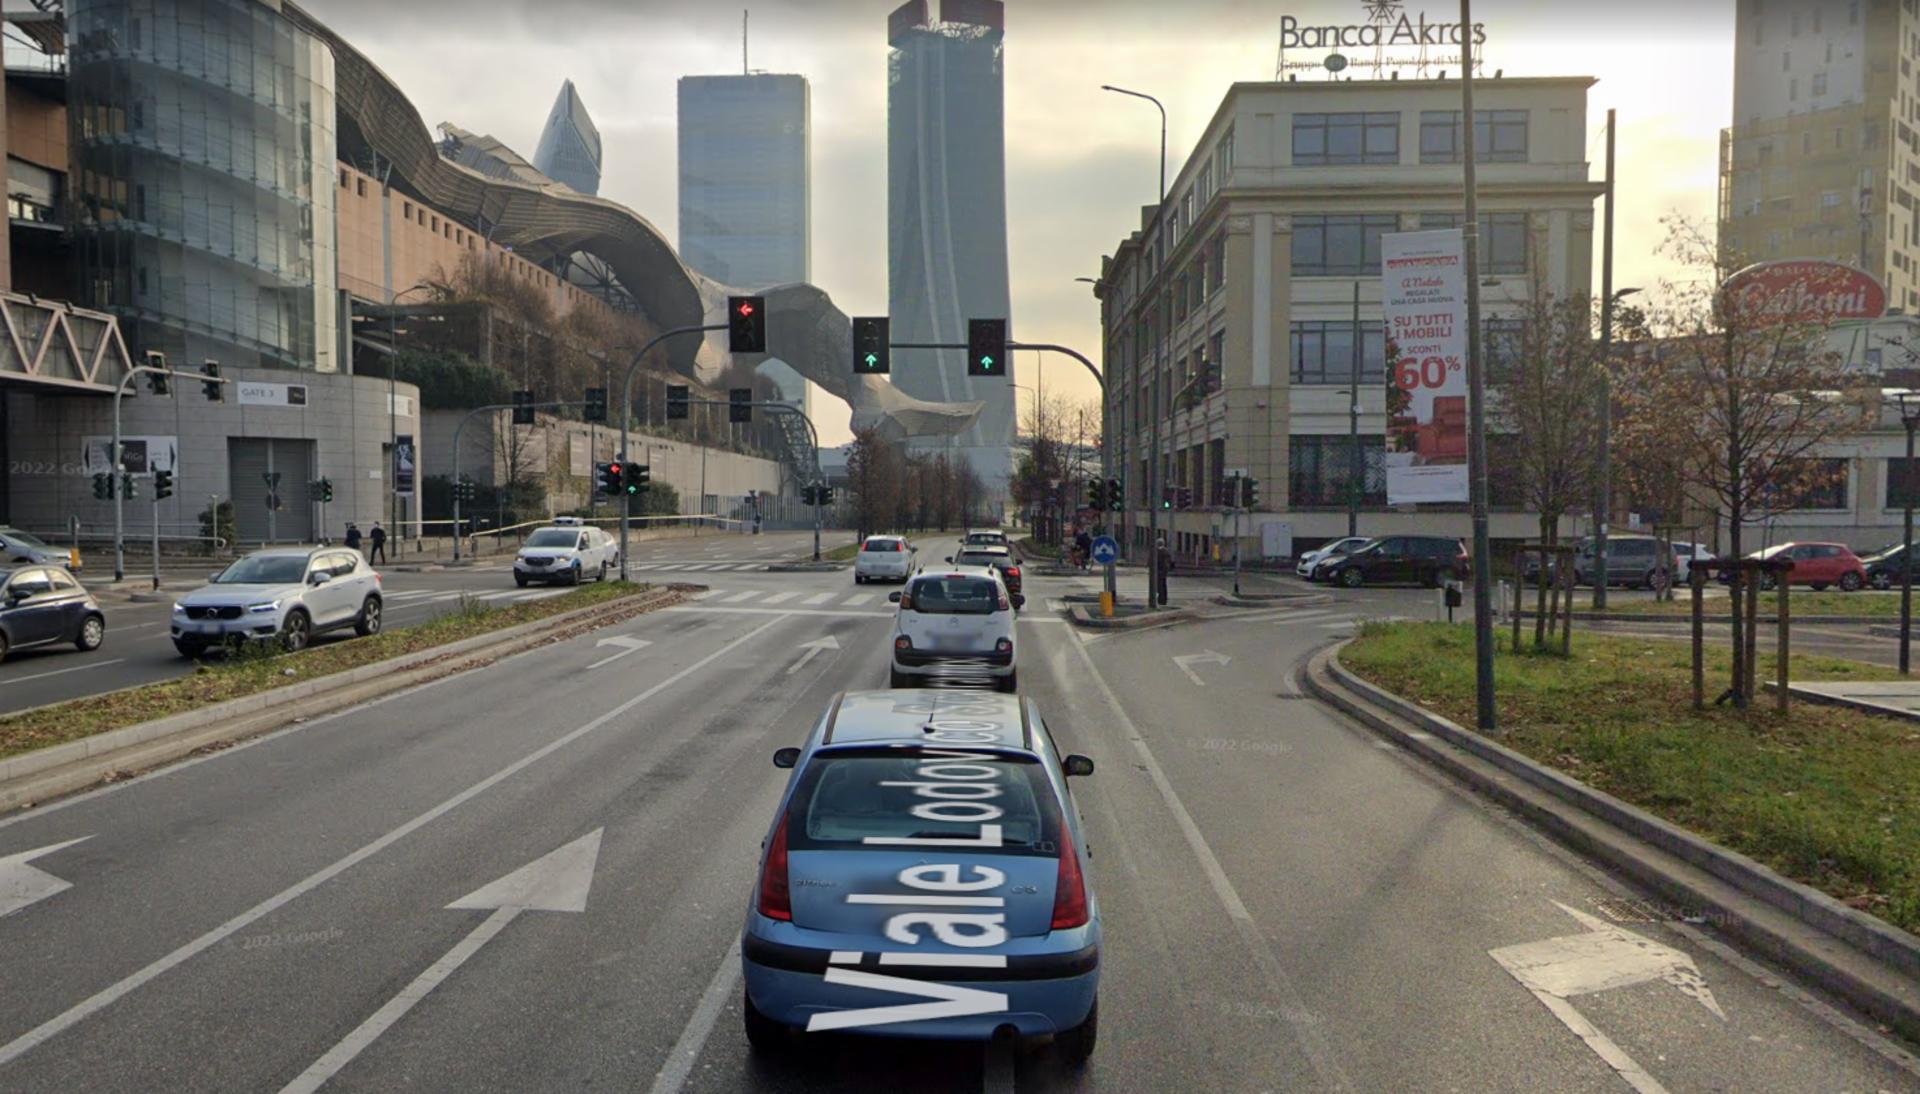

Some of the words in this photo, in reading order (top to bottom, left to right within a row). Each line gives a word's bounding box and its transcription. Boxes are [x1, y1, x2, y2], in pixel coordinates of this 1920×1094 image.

[1280, 15, 1380, 48] Banca
[1394, 315, 1412, 327] SU
[1415, 313, 1454, 325] TUTTI
[1404, 327, 1452, 339] MOBILI
[1407, 345, 1441, 354] SCONTI
[1395, 356, 1461, 390] 60%
[241, 387, 265, 398] GATE
